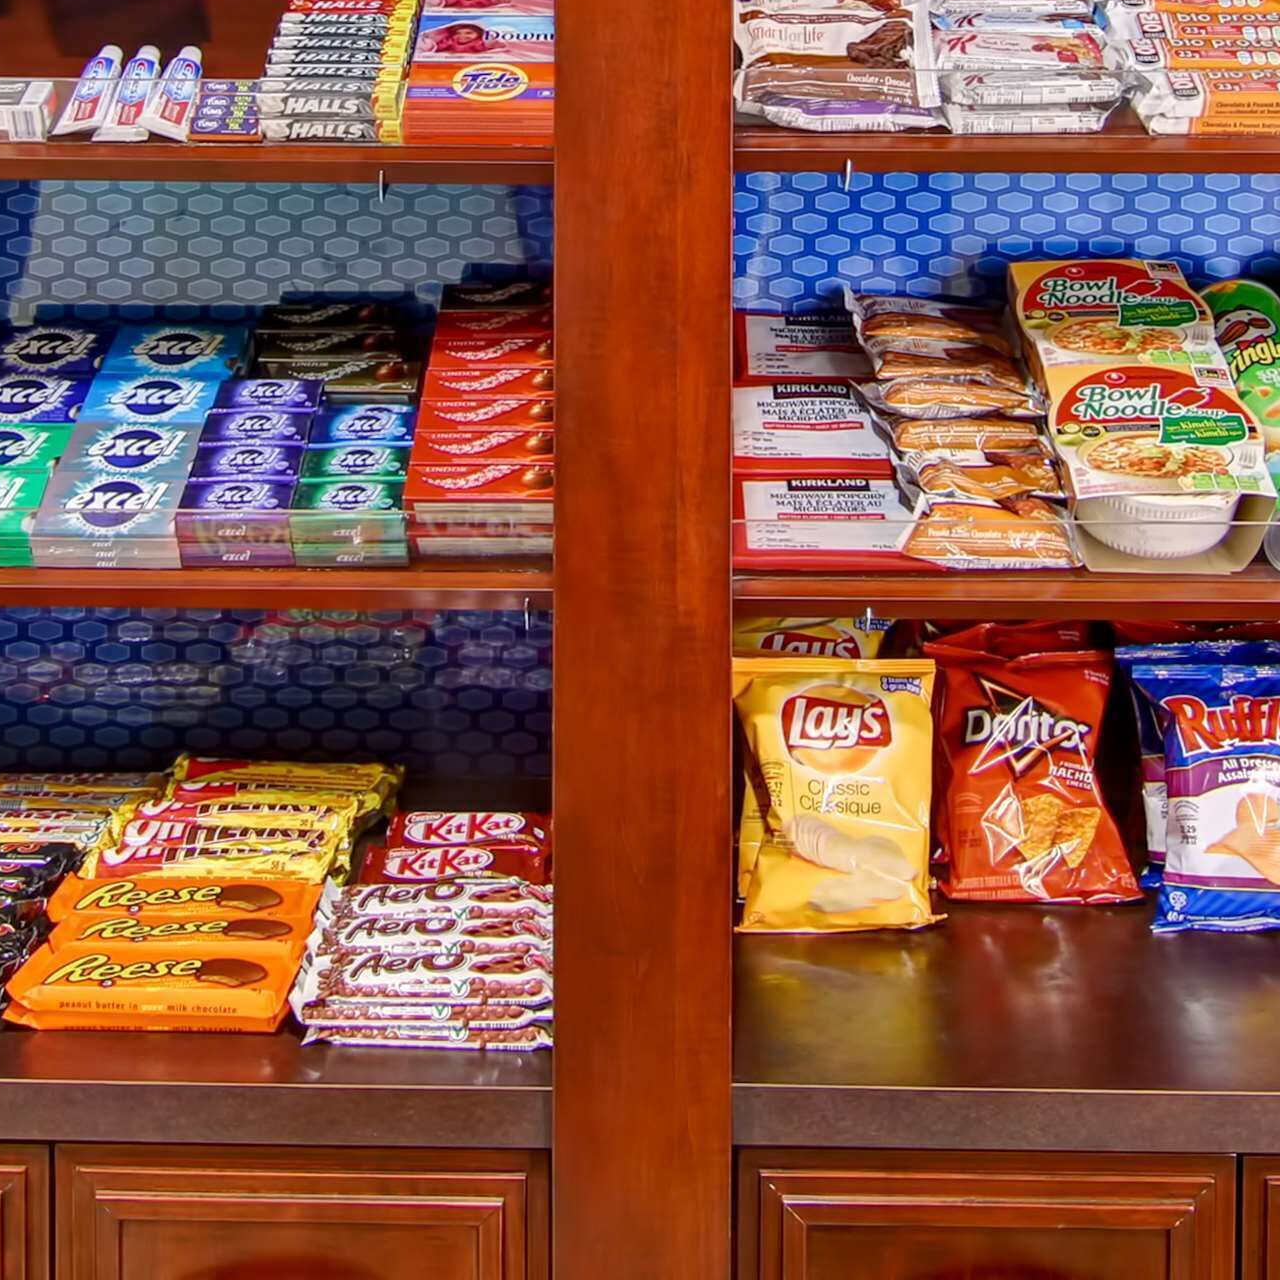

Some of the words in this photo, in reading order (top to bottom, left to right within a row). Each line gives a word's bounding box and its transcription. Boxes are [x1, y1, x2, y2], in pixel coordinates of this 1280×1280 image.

[313, 0, 383, 10] HALLS
[303, 12, 376, 23] HALLS
[1176, 12, 1210, 23] bio
[302, 24, 372, 36] HALLS
[298, 38, 370, 49] HALLS
[294, 51, 370, 62] HALLS
[290, 66, 366, 77] HALLS
[285, 80, 361, 92] HALLS
[460, 70, 521, 94] Tide
[283, 96, 360, 114] HALLS
[288, 121, 365, 139] HALLS
[1042, 276, 1117, 294] Bowl
[1038, 290, 1142, 307] Noodle
[2, 332, 97, 356] excel
[132, 333, 224, 356] excel
[109, 381, 205, 406] excel
[241, 381, 298, 397] excel
[776, 384, 848, 396] KIRKLAND
[1076, 383, 1161, 404] Bowl
[756, 400, 816, 409] MICROWAVE
[1071, 399, 1184, 419] Noodle
[228, 414, 288, 432] excel
[338, 415, 395, 432] excel
[1180, 419, 1215, 430] Kimchi
[1195, 428, 1229, 438] Kimchi
[86, 431, 187, 457] excel
[219, 447, 278, 466] excel
[330, 448, 390, 467] excel
[790, 478, 867, 488] KIRKLAND
[64, 482, 170, 510] excel
[207, 484, 266, 502] excel
[321, 484, 378, 503] excel
[770, 492, 830, 500] MICROWAVE
[831, 492, 886, 500] POPCORN
[787, 697, 885, 749] Lay's
[965, 709, 1092, 751] Doritos
[1222, 757, 1238, 771] All
[1048, 766, 1093, 783] NACHO
[74, 881, 223, 912] Reese
[357, 883, 466, 910] Aero
[80, 917, 229, 941] Reese
[344, 918, 457, 941] Aero
[43, 953, 204, 986] Reese
[349, 954, 464, 981] Aero
[58, 1001, 93, 1012] peanut
[95, 1001, 126, 1012] butter
[128, 1002, 139, 1011] in
[166, 1003, 188, 1013] milk
[190, 1005, 238, 1016] chocolate
